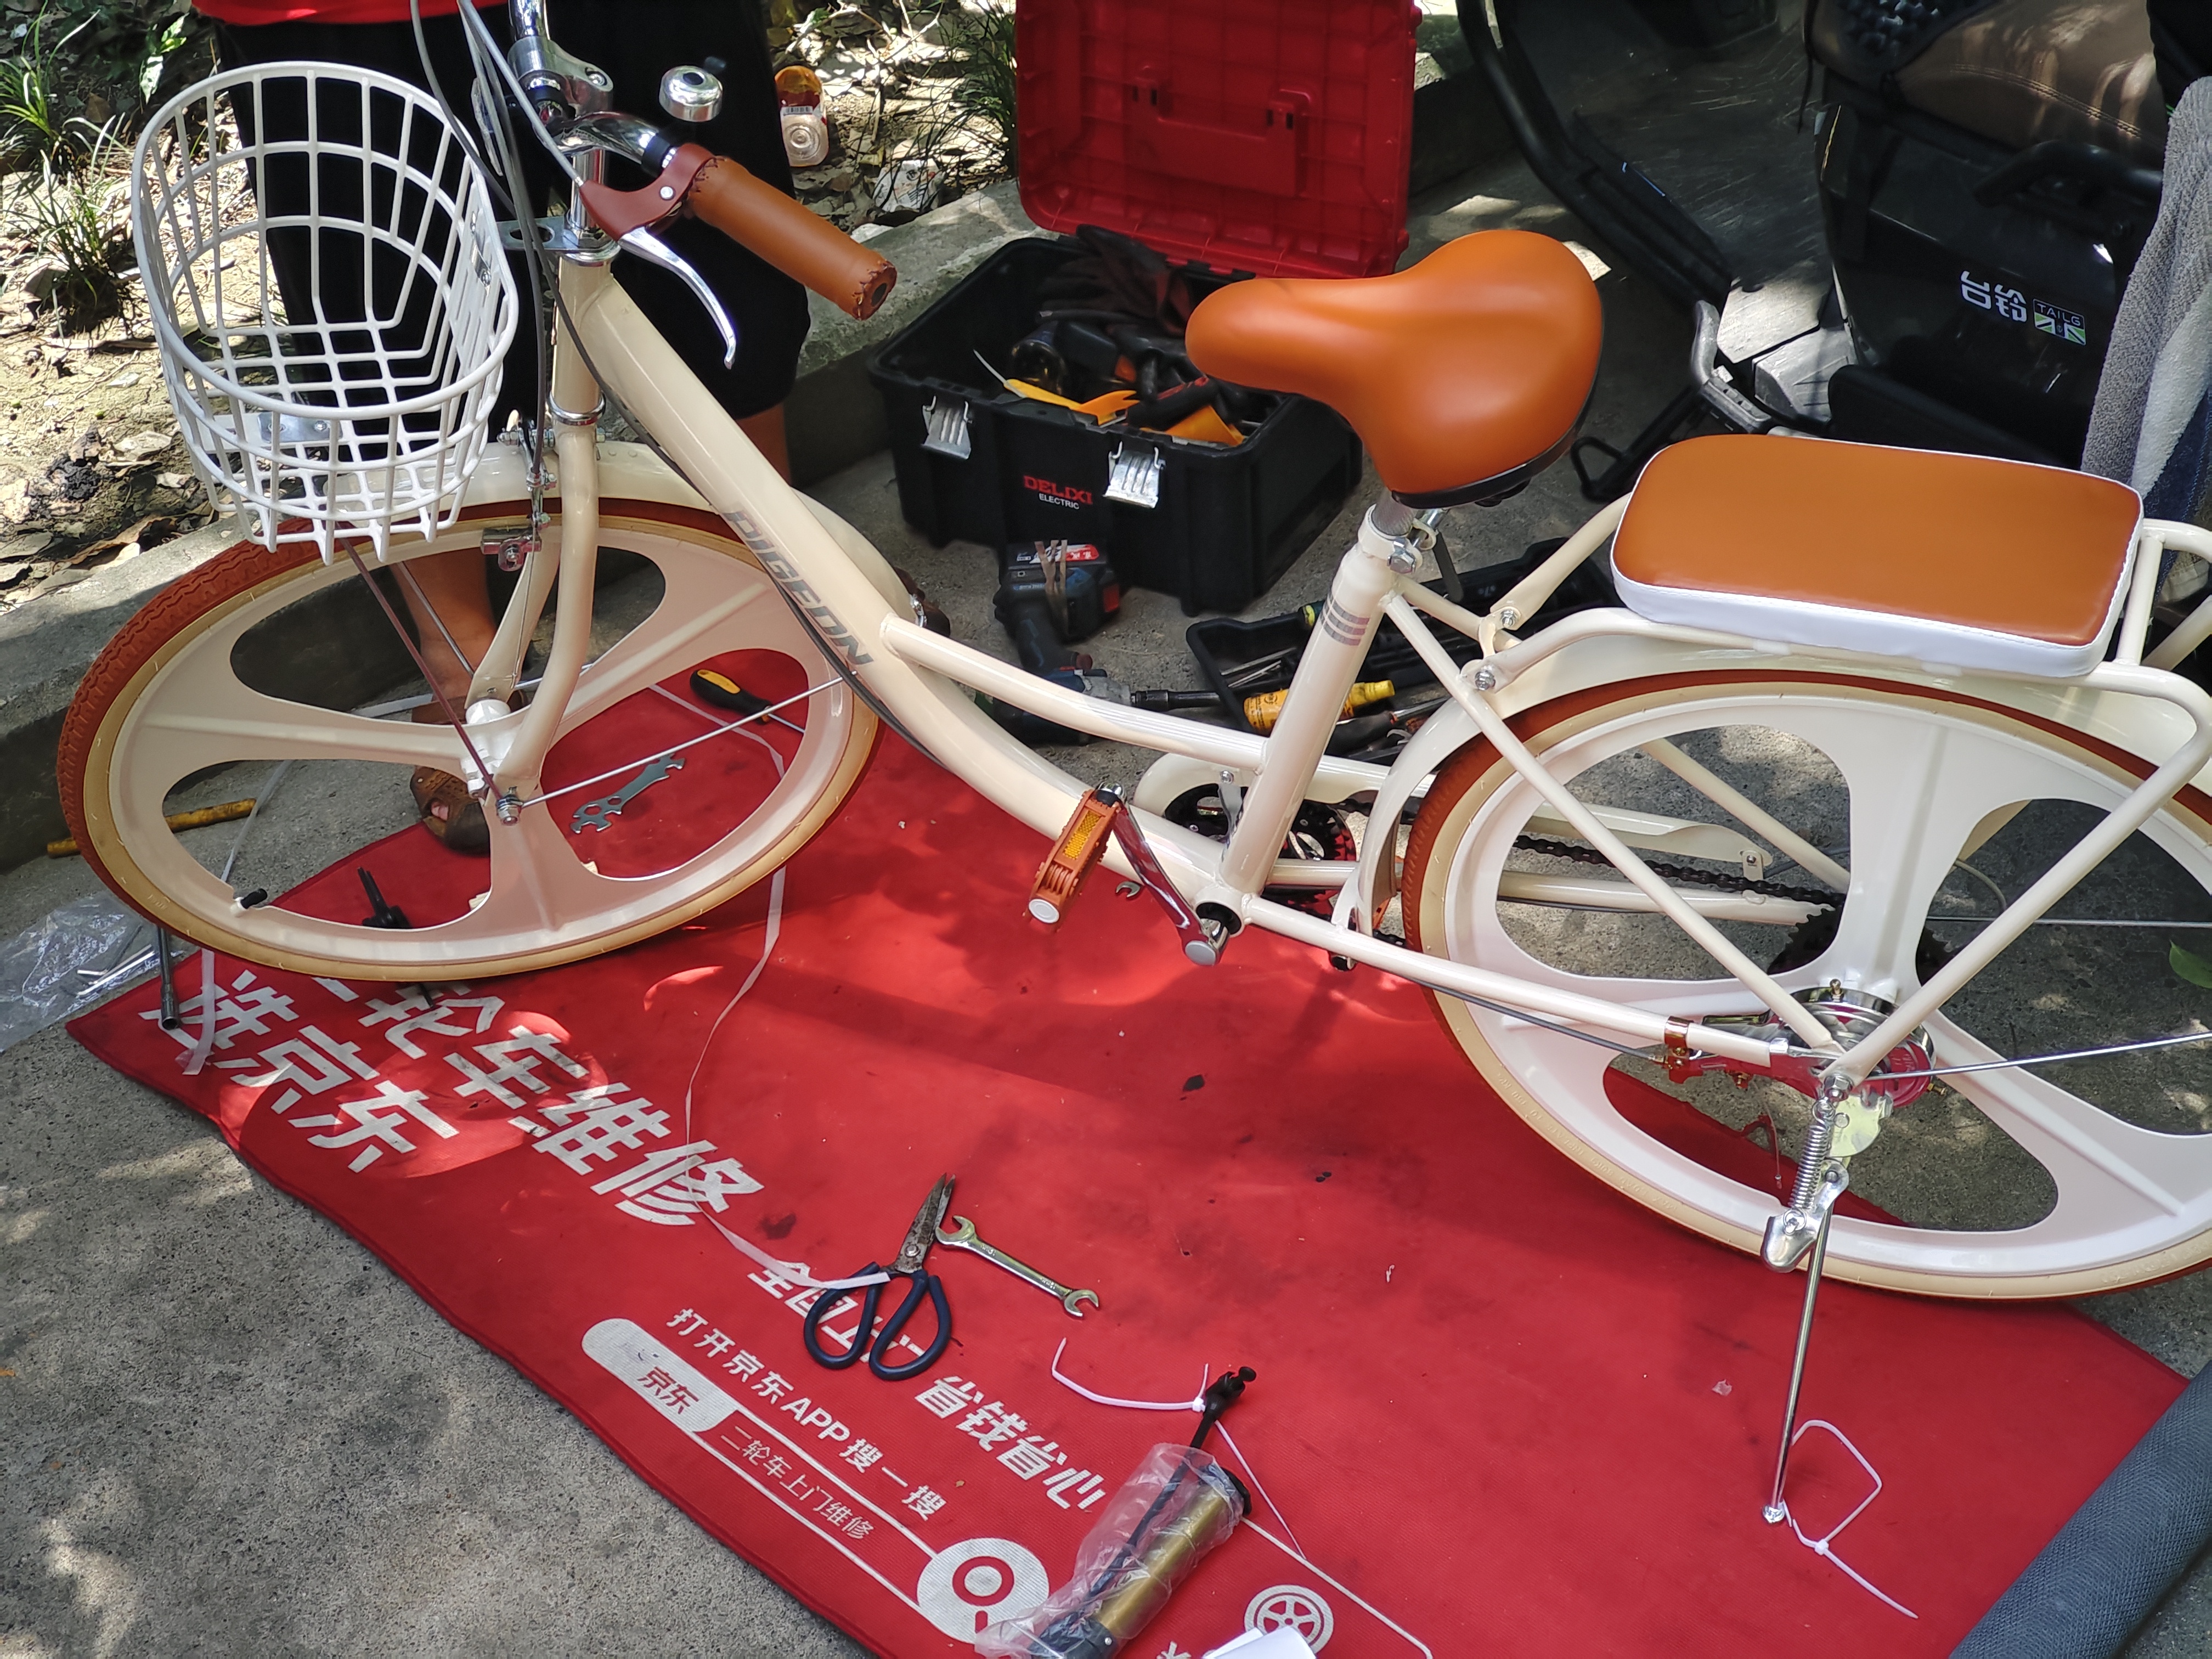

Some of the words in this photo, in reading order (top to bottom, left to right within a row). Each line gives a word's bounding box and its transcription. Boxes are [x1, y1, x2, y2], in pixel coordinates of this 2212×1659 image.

[2037, 303, 2081, 326] TAILG
[1024, 475, 1093, 505] DELIXI
[1039, 493, 1080, 510] ELECTRIC
[722, 510, 874, 664] PIGEON
[636, 1366, 699, 1415] 京东
[915, 1375, 1107, 1510] 省钱省心
[720, 1425, 874, 1540] 二轮车上门维修
